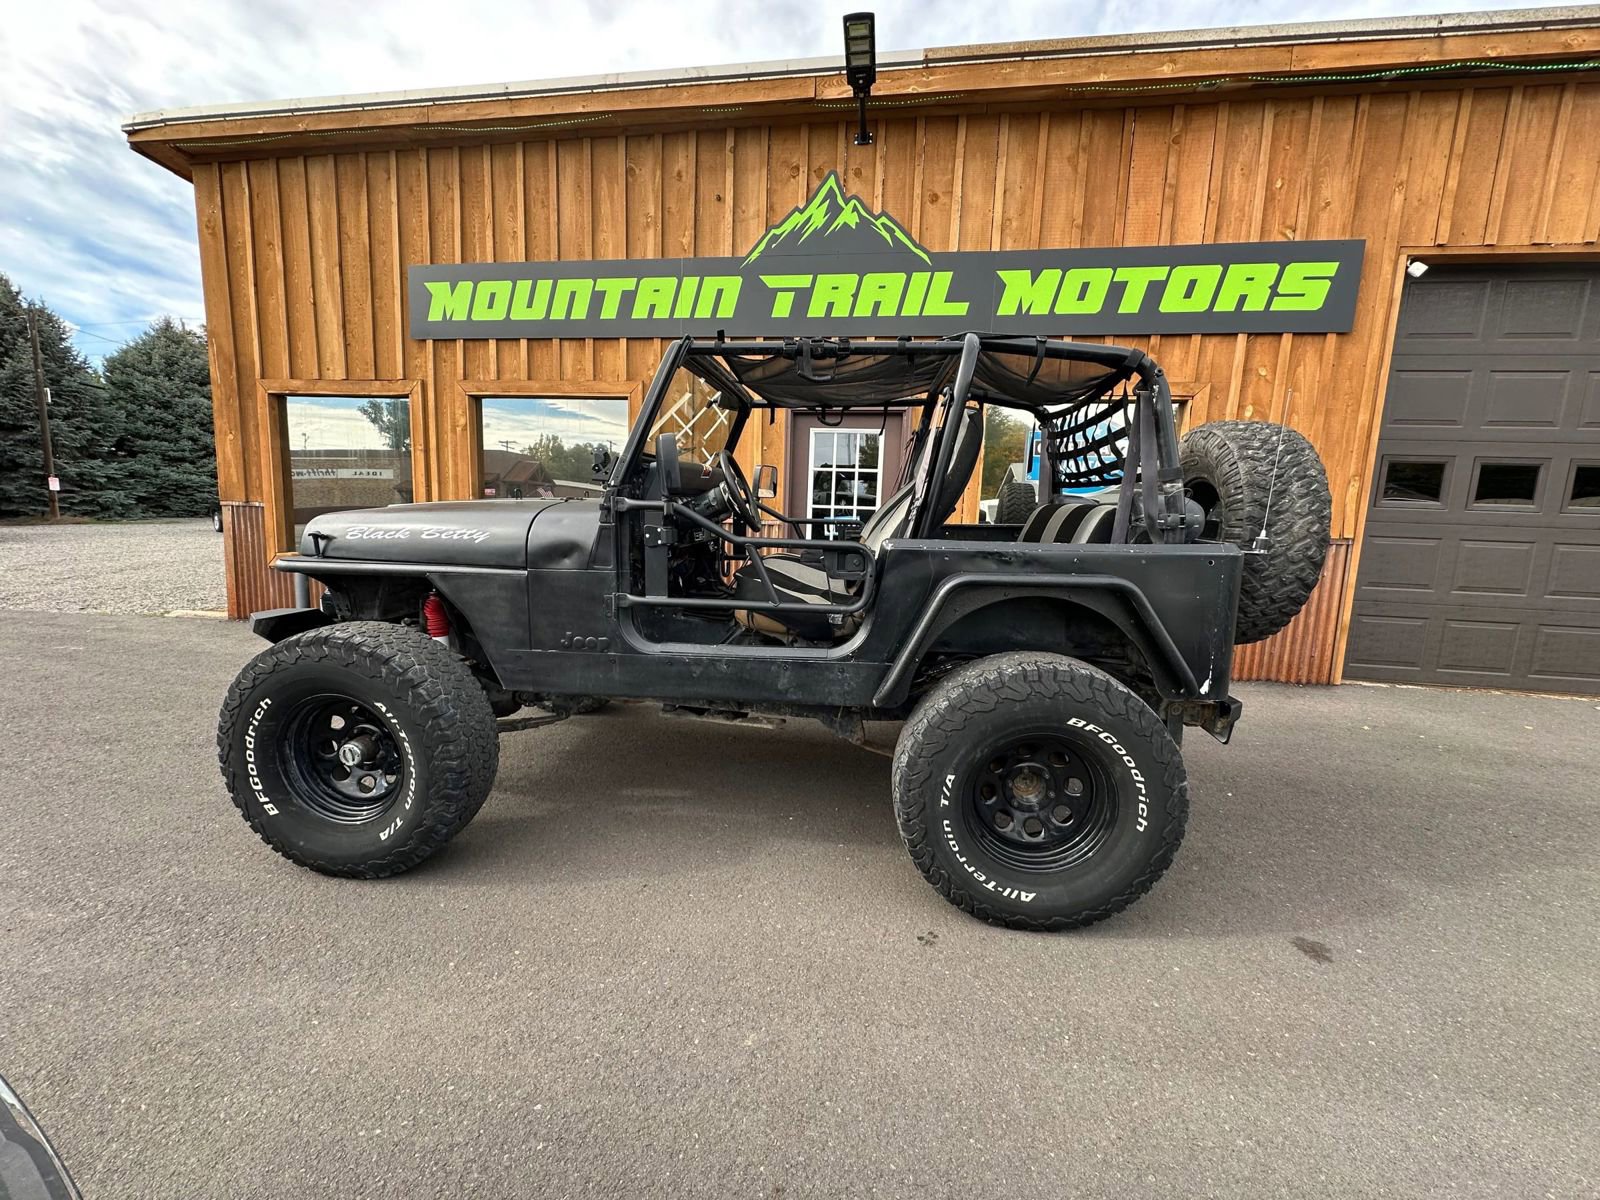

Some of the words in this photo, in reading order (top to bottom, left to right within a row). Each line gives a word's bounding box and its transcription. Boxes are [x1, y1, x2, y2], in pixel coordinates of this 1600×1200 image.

[424, 275, 743, 321] MOUNTAIN
[760, 271, 969, 317] TRAIL
[996, 262, 1340, 315] MOTORS
[345, 526, 411, 540] Black
[420, 527, 490, 544] Betty
[560, 631, 609, 651] Jeep
[245, 698, 279, 816] BFGoodrich
[373, 702, 416, 810] All-Terrain
[1067, 717, 1149, 832] BFGoodrich
[940, 774, 956, 808] T/A
[379, 817, 403, 841] T/A
[942, 819, 1037, 903] All-Terrain
